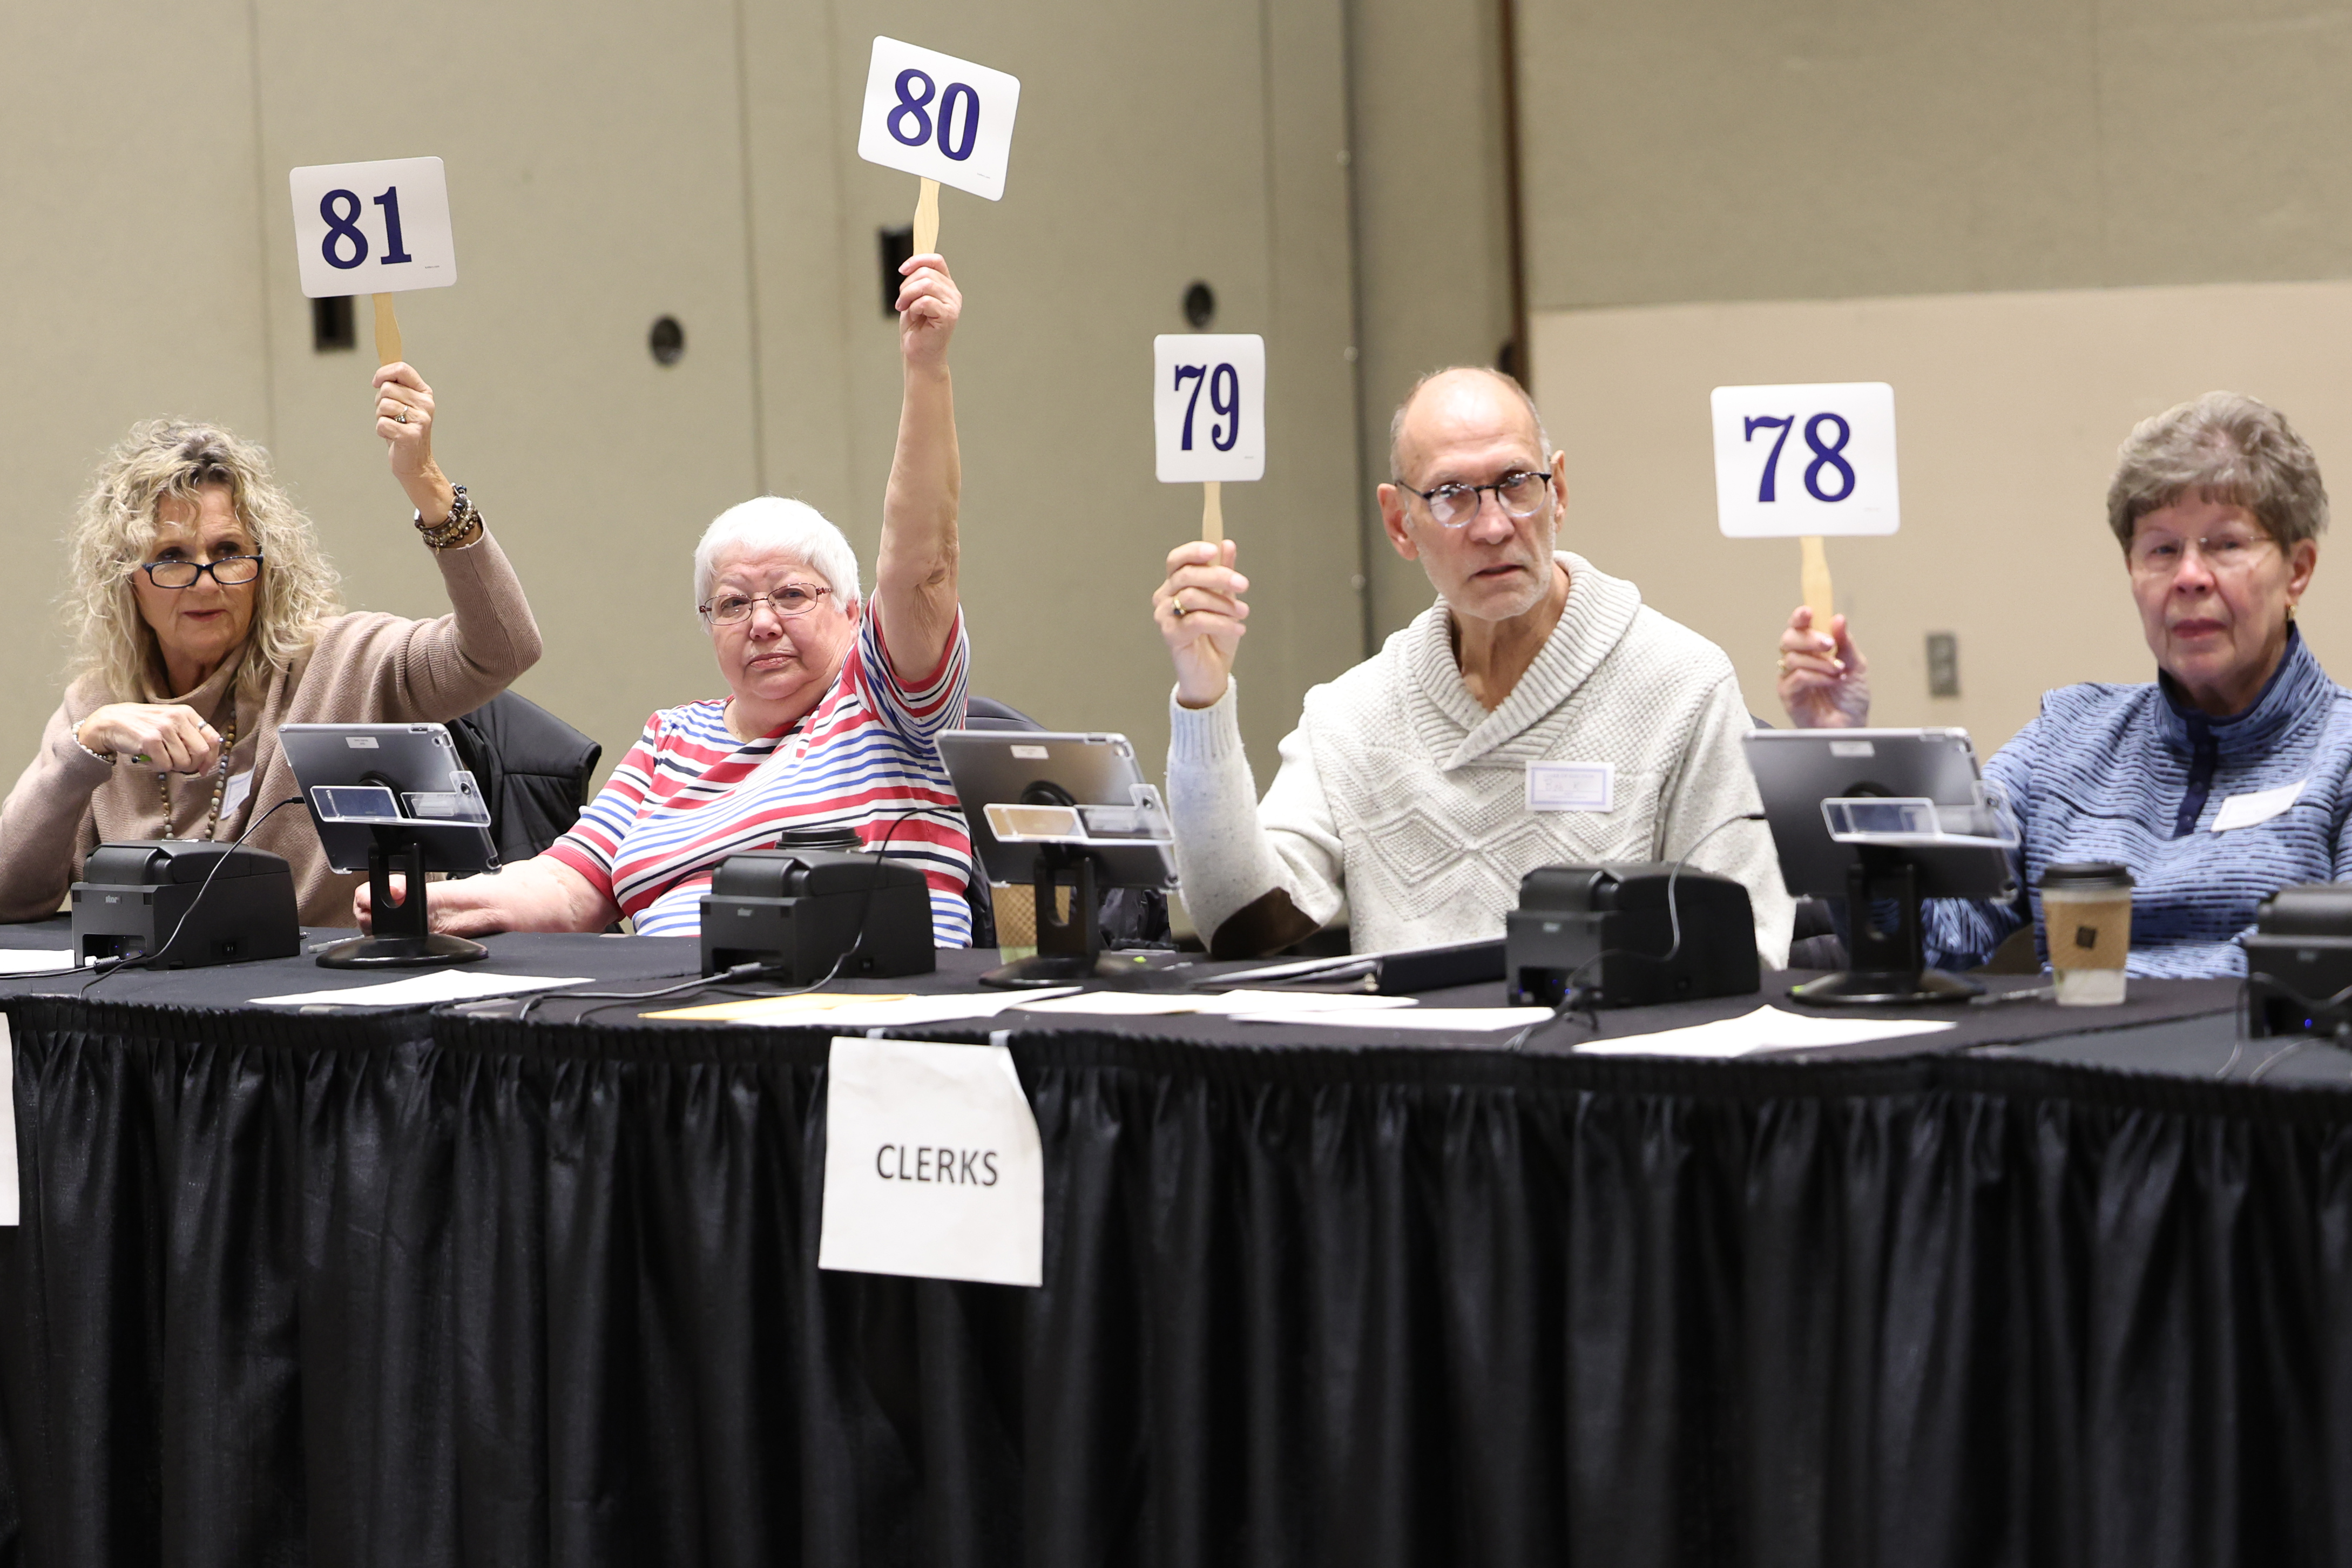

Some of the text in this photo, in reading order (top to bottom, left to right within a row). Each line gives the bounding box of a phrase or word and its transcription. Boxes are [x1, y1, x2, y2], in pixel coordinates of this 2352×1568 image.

[887, 69, 979, 161] 80
[320, 186, 411, 269] 81
[1174, 363, 1239, 451] 79
[1745, 413, 1855, 502] 78
[877, 1144, 998, 1186] CLERKS
